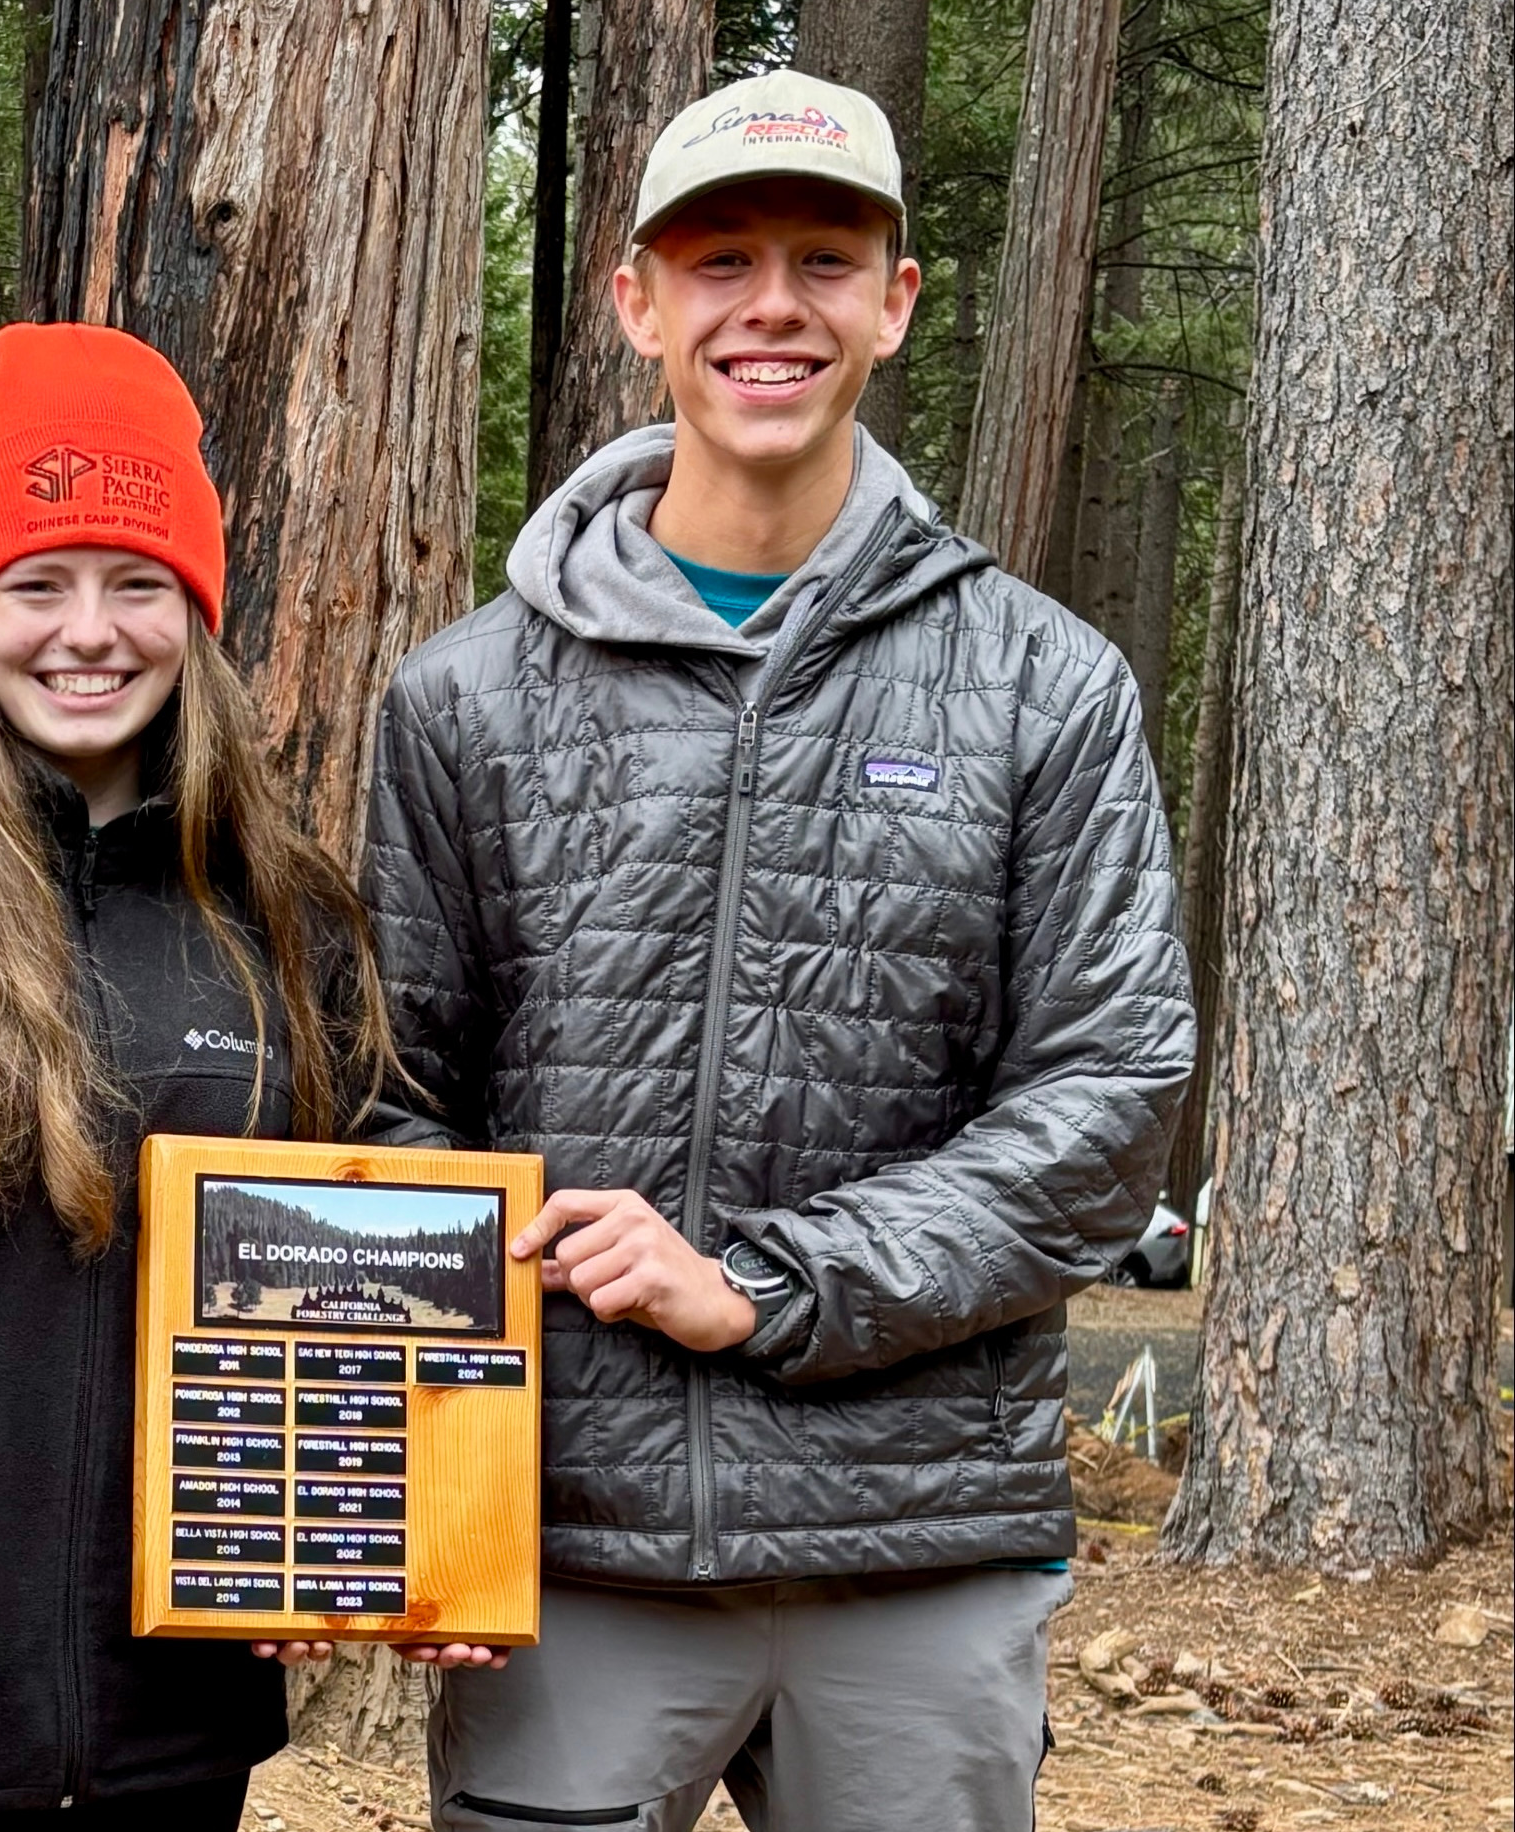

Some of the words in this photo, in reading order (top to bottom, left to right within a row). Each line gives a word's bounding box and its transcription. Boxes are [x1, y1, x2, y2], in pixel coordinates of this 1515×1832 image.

[682, 106, 806, 149] Sierra
[744, 124, 848, 143] RESCUE
[742, 135, 851, 153] INTERNATIONAL
[102, 455, 164, 487] SIERRA
[102, 475, 170, 510] PACIFIC
[26, 514, 79, 533] CHINESE
[84, 513, 119, 526] CAMP
[123, 514, 169, 541] DIVISION
[205, 1029, 274, 1060] Columa
[238, 1242, 262, 1260] EL
[266, 1244, 348, 1264] DORADO
[352, 1248, 465, 1270] CHAMPIONS
[320, 1300, 382, 1312] CALIFORNIA
[296, 1310, 345, 1320] FORESTRY
[346, 1311, 407, 1323] CHALLENGE
[175, 1342, 224, 1355] PONDEROSA
[227, 1345, 247, 1356] HIGH
[250, 1346, 283, 1357] SCHOOL
[315, 1348, 332, 1358] NEW
[355, 1349, 372, 1360] HIGH
[374, 1350, 403, 1361] SCHOOL
[219, 1360, 240, 1371] 2011
[418, 1352, 467, 1364] FORESTHILL
[470, 1354, 489, 1365] HIGH
[490, 1354, 523, 1366] SCHOOL
[339, 1365, 362, 1375] 2017
[457, 1368, 484, 1379] 2024
[175, 1389, 224, 1401] PONDEROSA
[227, 1391, 247, 1402] HIGH
[250, 1392, 283, 1404] SCHOOL
[298, 1393, 347, 1405] FORESTHILL
[349, 1395, 369, 1405] HIGH
[371, 1395, 403, 1407] SCHOOL
[217, 1407, 241, 1418] 2012
[338, 1410, 363, 1421] 2018
[176, 1434, 220, 1446] FRANKLIN
[221, 1436, 243, 1447] HIGH
[245, 1437, 282, 1449] SCHOOL
[298, 1439, 347, 1451] FORESTHILL
[349, 1441, 369, 1452] HIGH
[370, 1442, 403, 1453] SCHOOL
[217, 1452, 241, 1462] 2013
[338, 1456, 363, 1467] 2019
[179, 1480, 217, 1491] AMADOR
[219, 1482, 241, 1492] HIGH
[243, 1483, 279, 1495] SCHOOL
[297, 1485, 308, 1496] EL
[310, 1486, 345, 1497] DORADO
[347, 1487, 367, 1497] HIGH
[369, 1488, 402, 1498] SCHOOL
[217, 1497, 241, 1508] 2014
[338, 1503, 362, 1513] 2021
[175, 1527, 201, 1538] BELLA
[204, 1528, 228, 1539] VISTA
[229, 1529, 248, 1540] HIGH
[250, 1530, 281, 1541] SCHOOL
[296, 1533, 308, 1542] EL
[310, 1533, 345, 1543] DORADO
[347, 1534, 366, 1544] HIGH
[369, 1534, 402, 1545] SCHOOL
[217, 1545, 241, 1555] 2015
[336, 1549, 363, 1559] 2022
[175, 1576, 196, 1586] VISTA
[214, 1576, 233, 1587] LAGO
[235, 1577, 251, 1587] HIGH
[253, 1577, 280, 1589] SCHOOL
[296, 1580, 317, 1590] MIRA
[319, 1580, 344, 1591] LOMA
[346, 1581, 366, 1591] HIGH
[368, 1581, 402, 1592] SCHOOL
[216, 1593, 240, 1603] 2016
[336, 1596, 363, 1607] 2023
